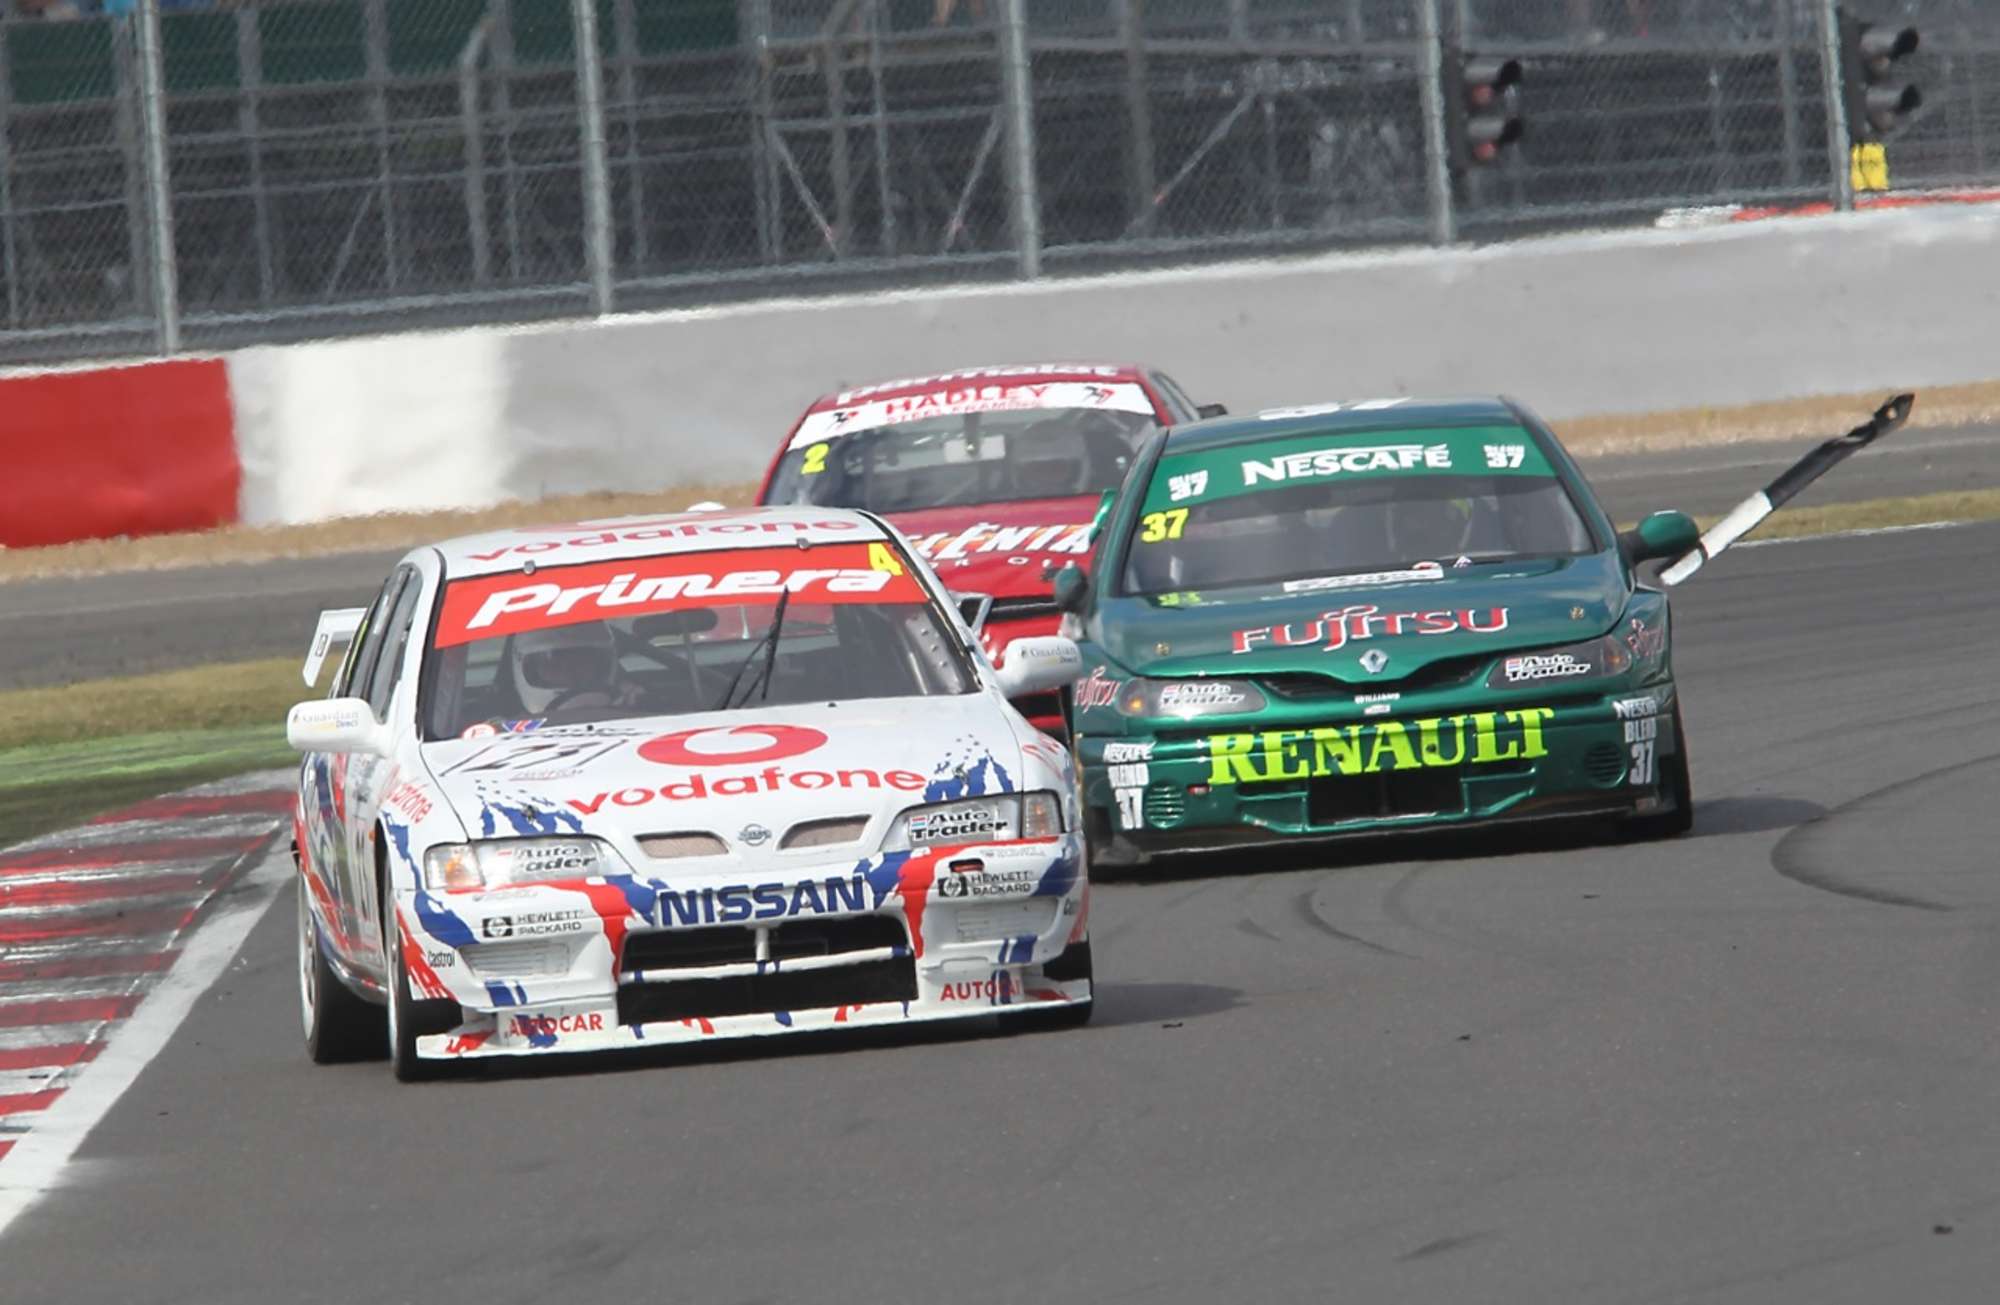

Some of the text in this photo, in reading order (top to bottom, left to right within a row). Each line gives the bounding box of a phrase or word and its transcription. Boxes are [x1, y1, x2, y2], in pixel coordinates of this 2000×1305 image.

[885, 386, 1049, 414] HADLEY
[801, 443, 830, 474] 2
[1243, 443, 1452, 487] NESCAFÉ
[468, 520, 859, 561] vodafone
[1142, 508, 1189, 543] 37
[868, 542, 903, 576] 4
[465, 569, 891, 630] Primera
[1208, 707, 1554, 785] RENAULT
[1629, 740, 1654, 785] 37
[565, 765, 926, 815] vodafone
[912, 820, 1008, 841] Trader
[927, 810, 990, 825] Auto
[520, 857, 596, 871] ader
[971, 871, 1029, 882] HEWLETT
[658, 875, 865, 926] NISSAN
[972, 883, 1031, 895] PACKARD
[517, 909, 580, 924] HEWLETT
[518, 921, 582, 936] PACKARD
